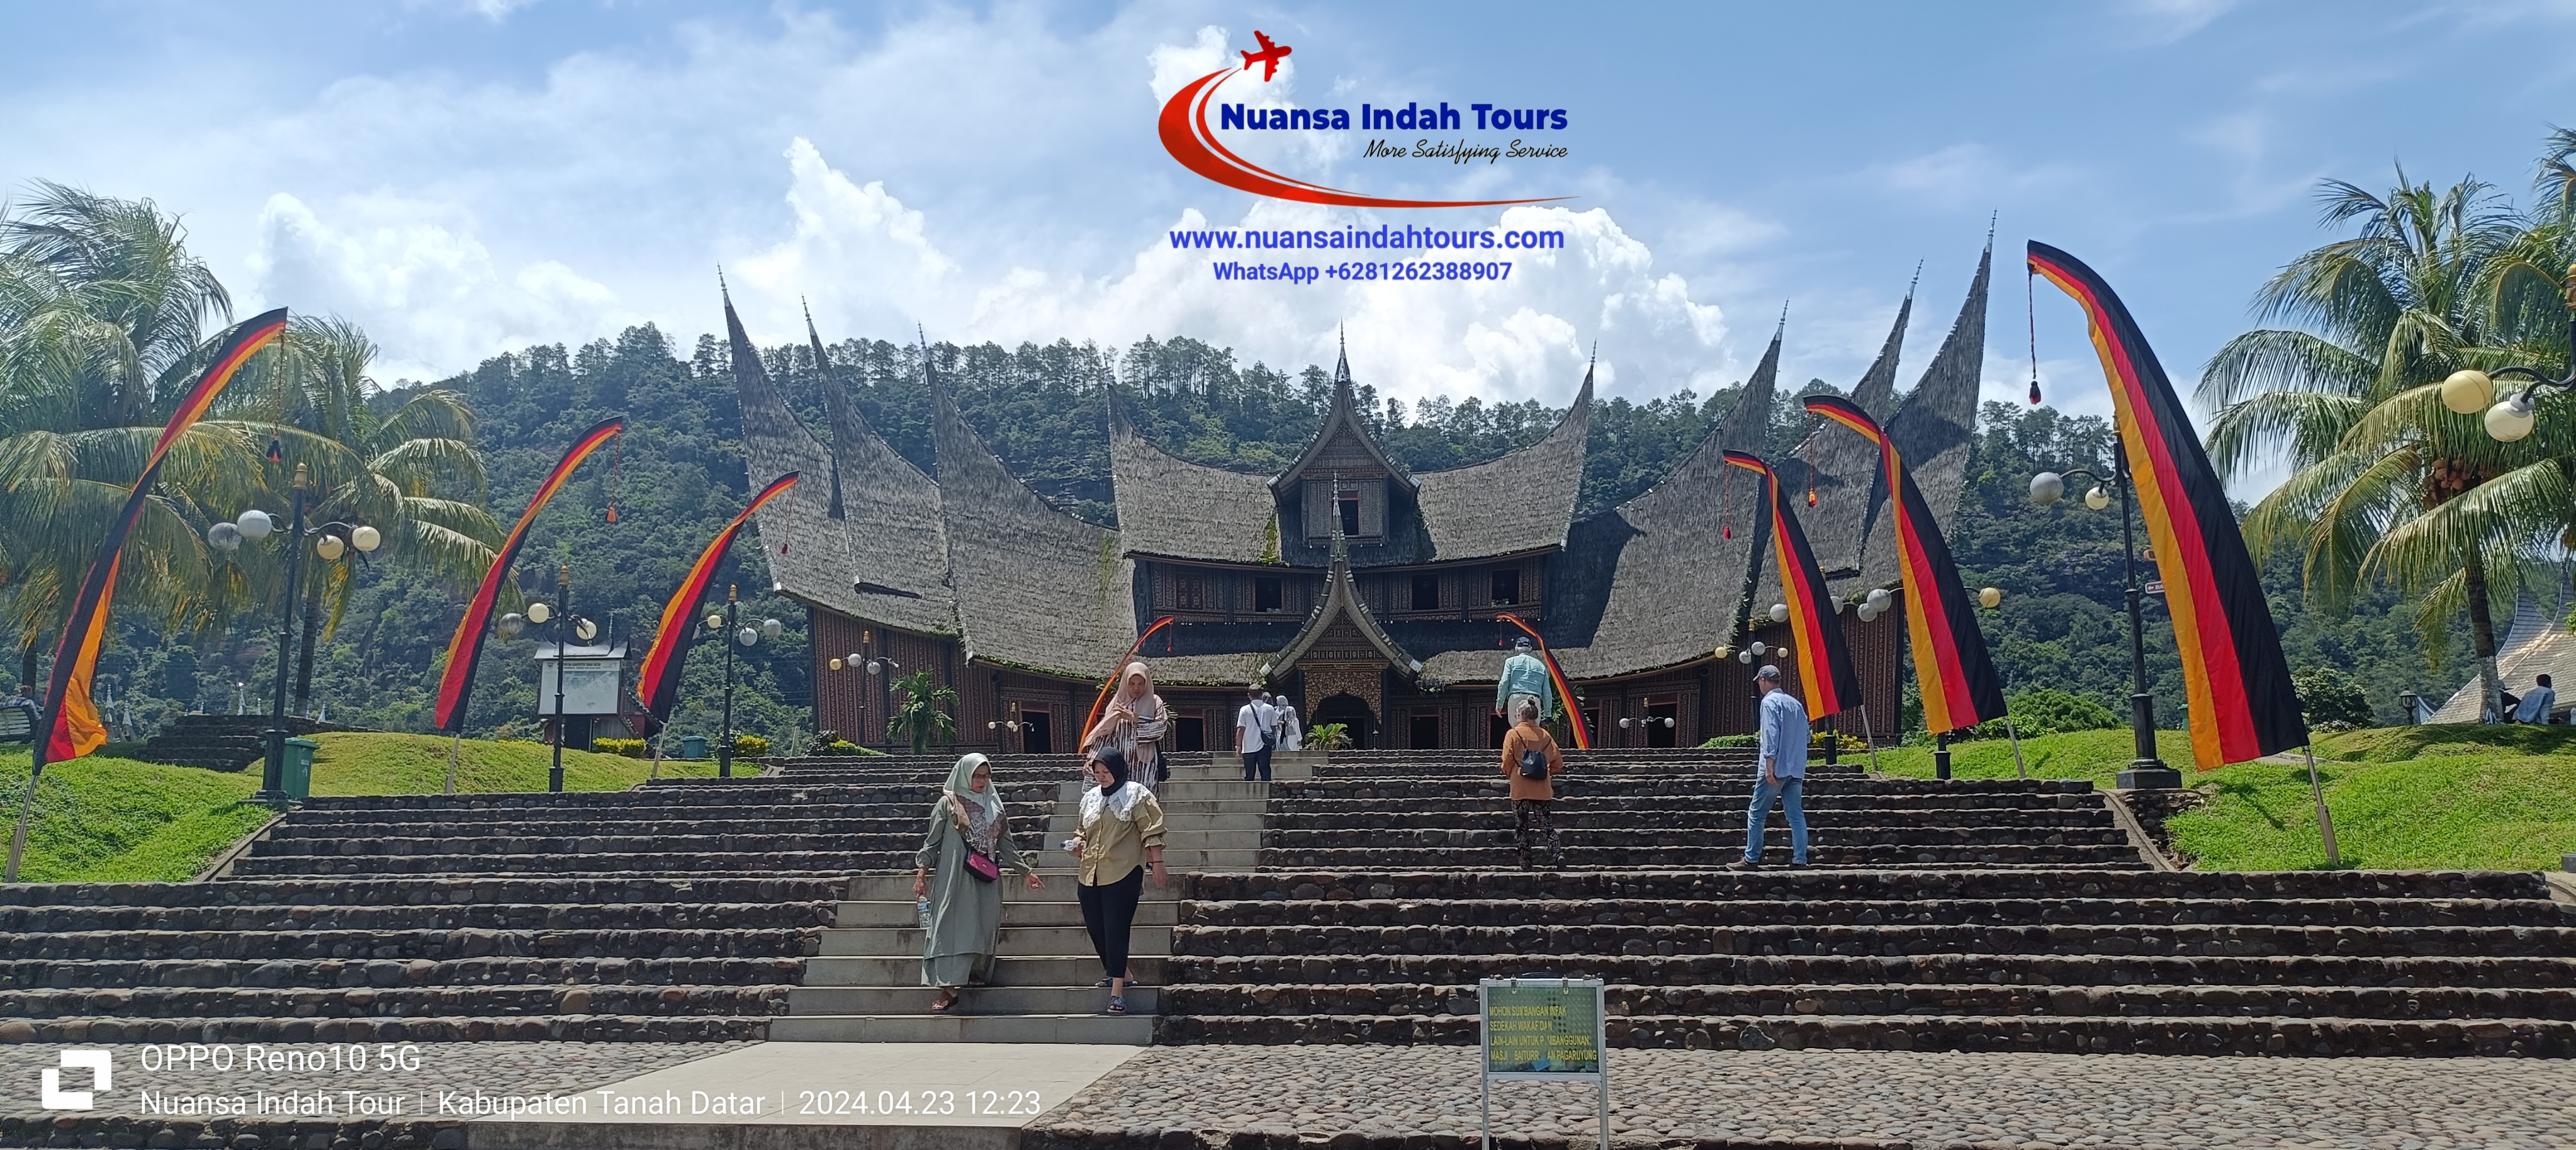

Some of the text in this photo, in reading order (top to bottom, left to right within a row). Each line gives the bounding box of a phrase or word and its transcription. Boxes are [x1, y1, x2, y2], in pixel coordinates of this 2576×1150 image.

[1489, 1005, 1567, 1016] MOHON SUMBANGAN INFAK
[1490, 1020, 1517, 1031] SEDEKAH
[1517, 1020, 1539, 1030] WAKAF
[1490, 1035, 1590, 1046] LAIN-LAIN UNTUK PMBANGGUNAN
[1491, 1051, 1509, 1061] MASJI
[1556, 1050, 1597, 1060] PAGARUYUNG
